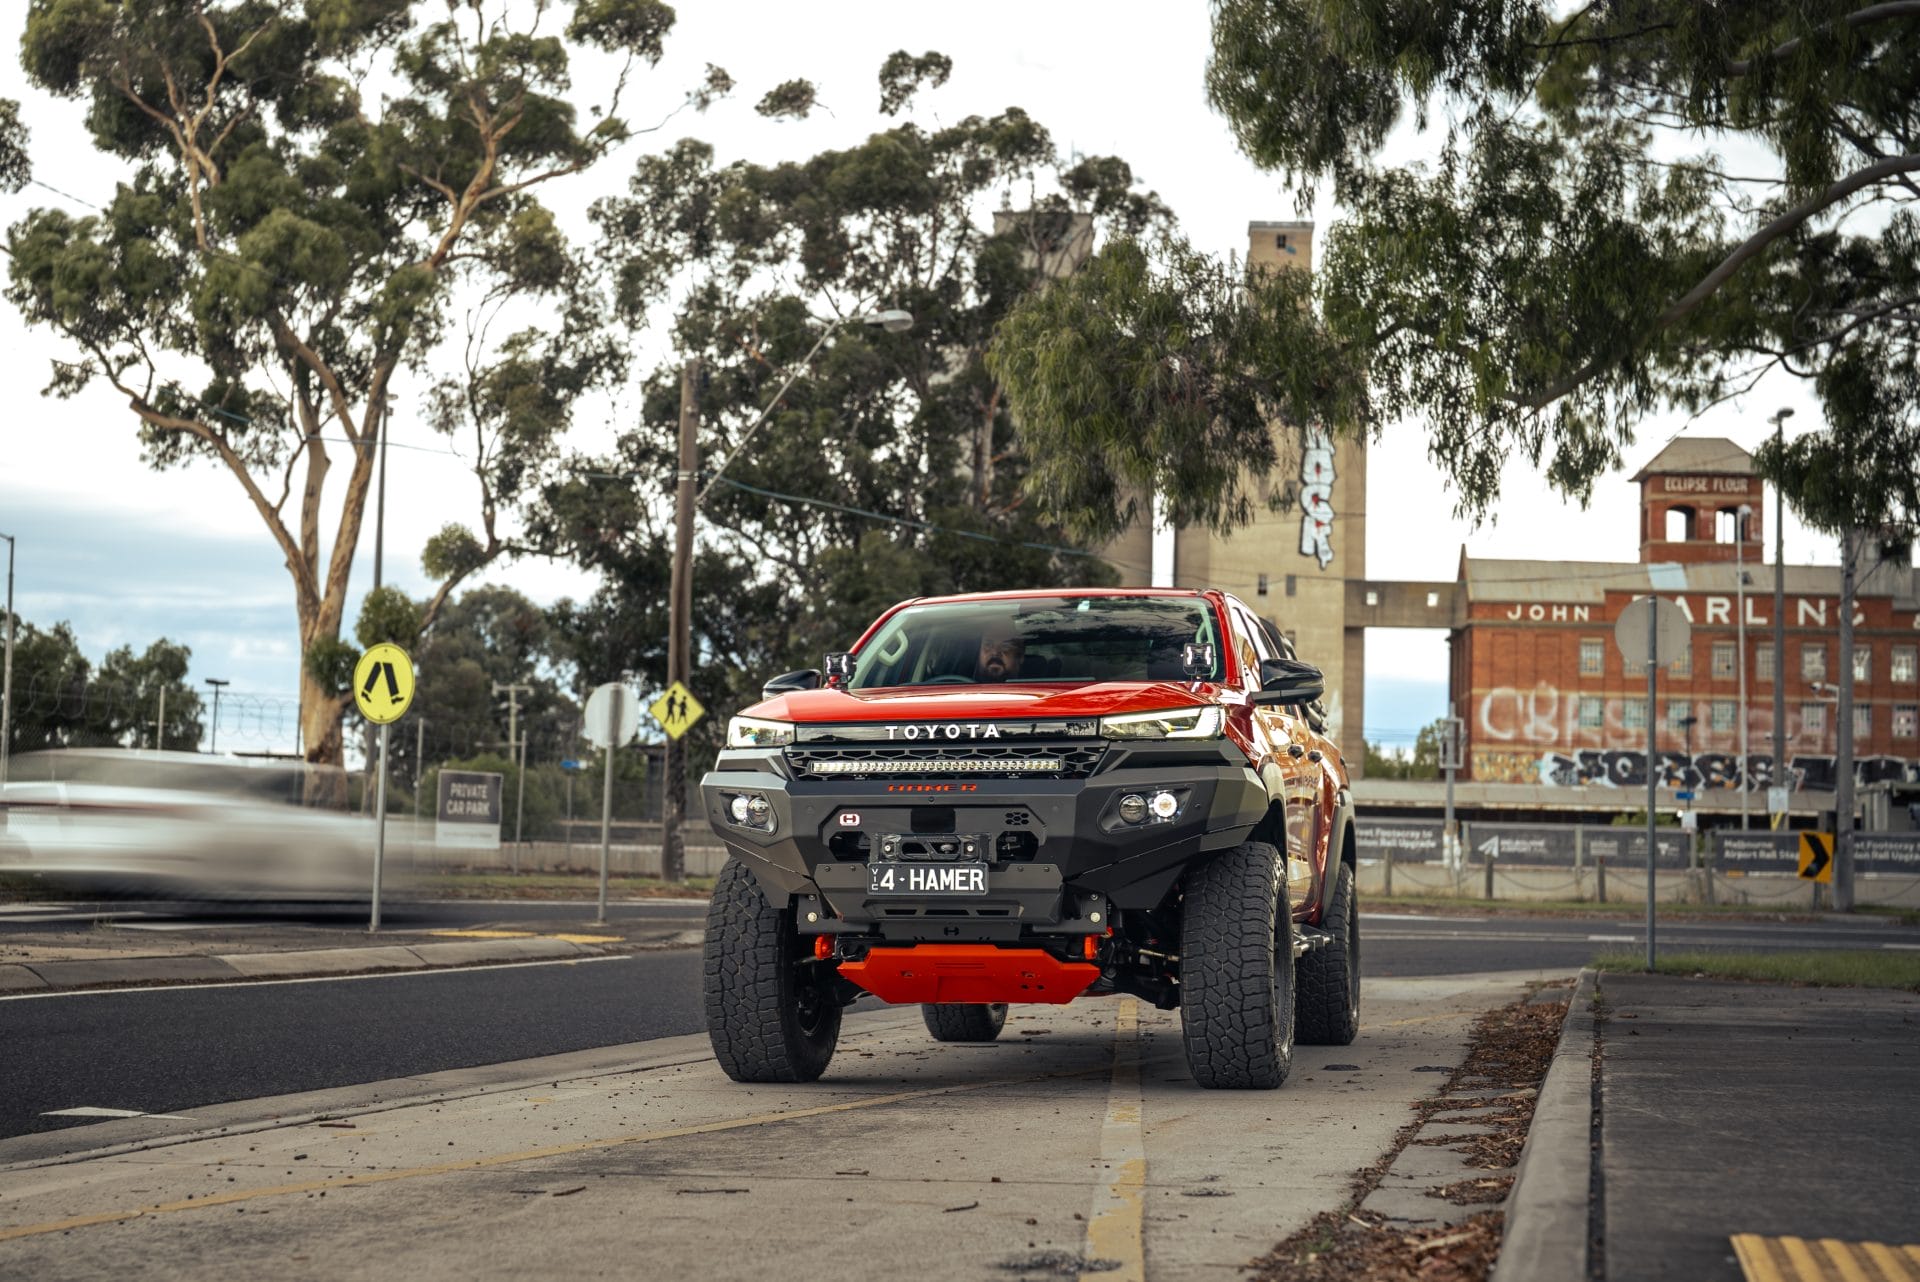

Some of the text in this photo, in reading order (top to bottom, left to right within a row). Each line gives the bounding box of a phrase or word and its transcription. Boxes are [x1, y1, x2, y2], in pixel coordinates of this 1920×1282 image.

[1664, 476, 1748, 493] ECLIPSE FLOUR
[1507, 603, 1590, 622] JOHN
[885, 724, 1000, 740] TOYOTA
[450, 782, 489, 799] PRIVATE
[446, 799, 491, 816] CAR PARK
